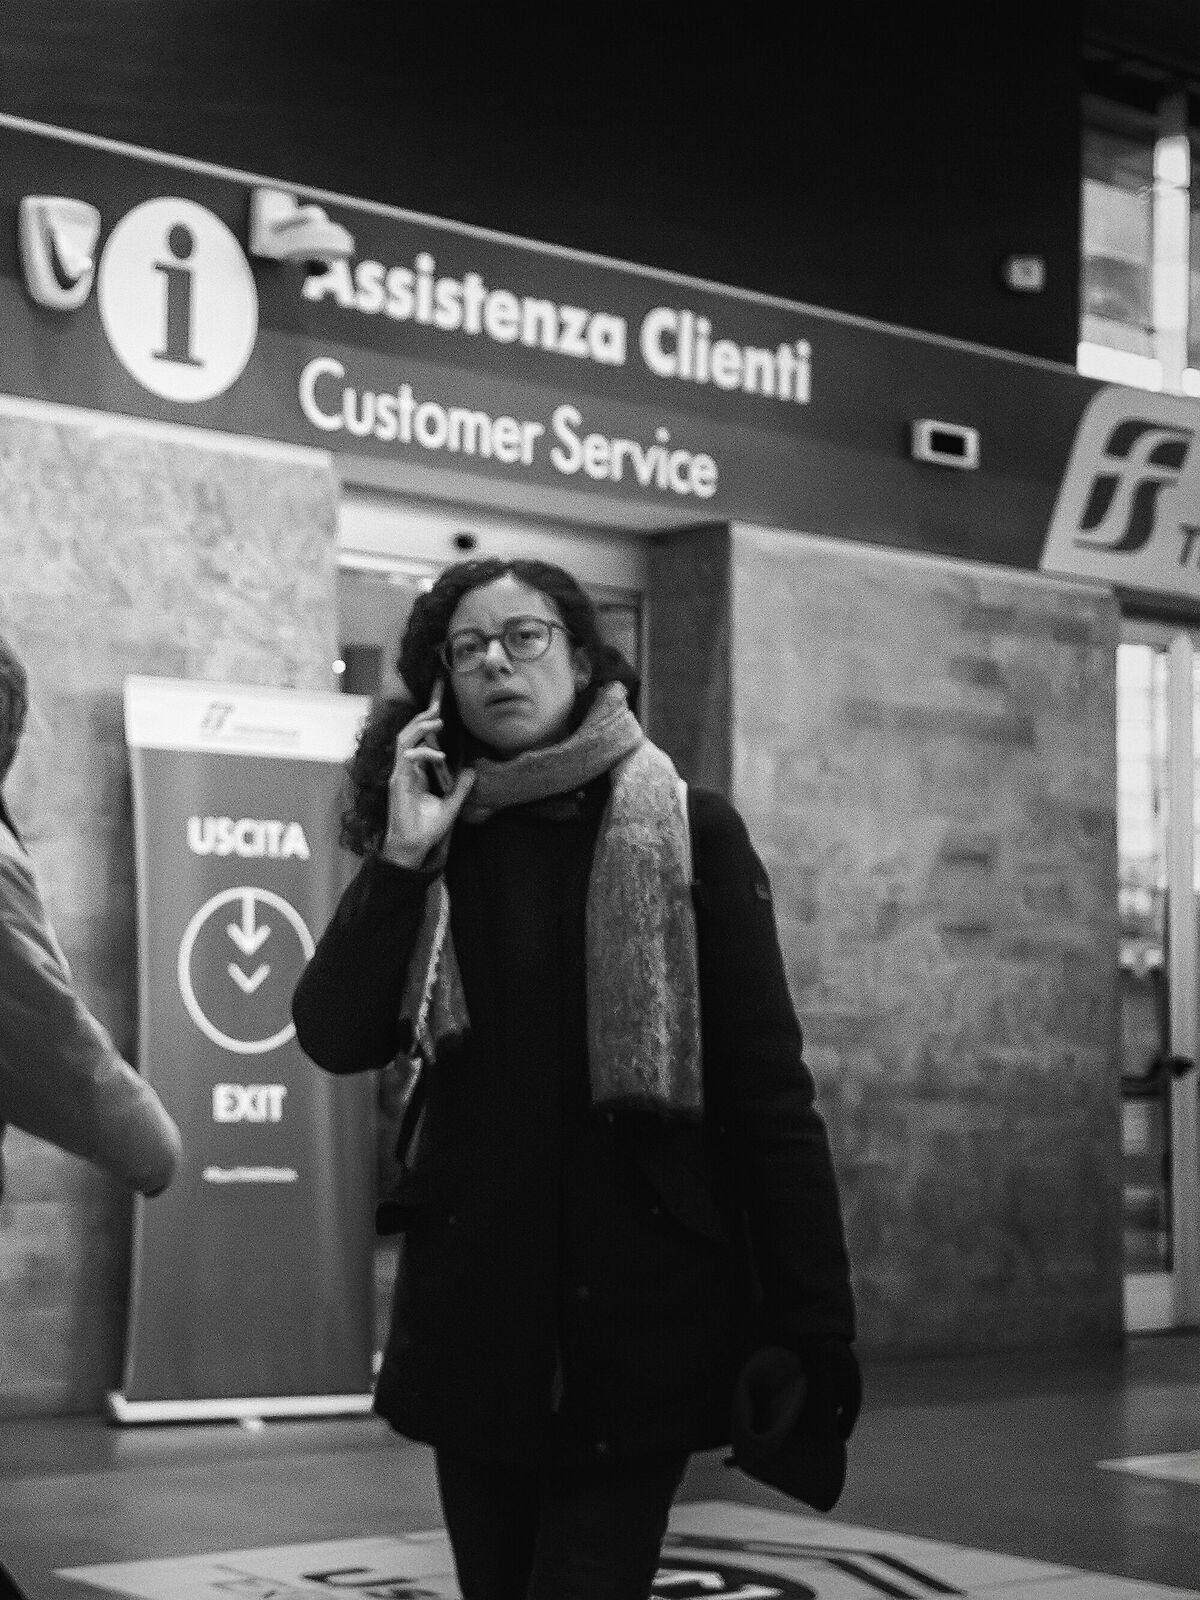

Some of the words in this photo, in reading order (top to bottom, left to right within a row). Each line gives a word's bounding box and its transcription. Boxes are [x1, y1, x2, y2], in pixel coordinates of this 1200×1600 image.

[301, 250, 627, 366] Assistenza
[640, 306, 813, 404] Clienti
[299, 356, 544, 464] Customer
[551, 404, 719, 499] Service
[187, 816, 310, 860] USCITA
[212, 1084, 287, 1123] EXIT
